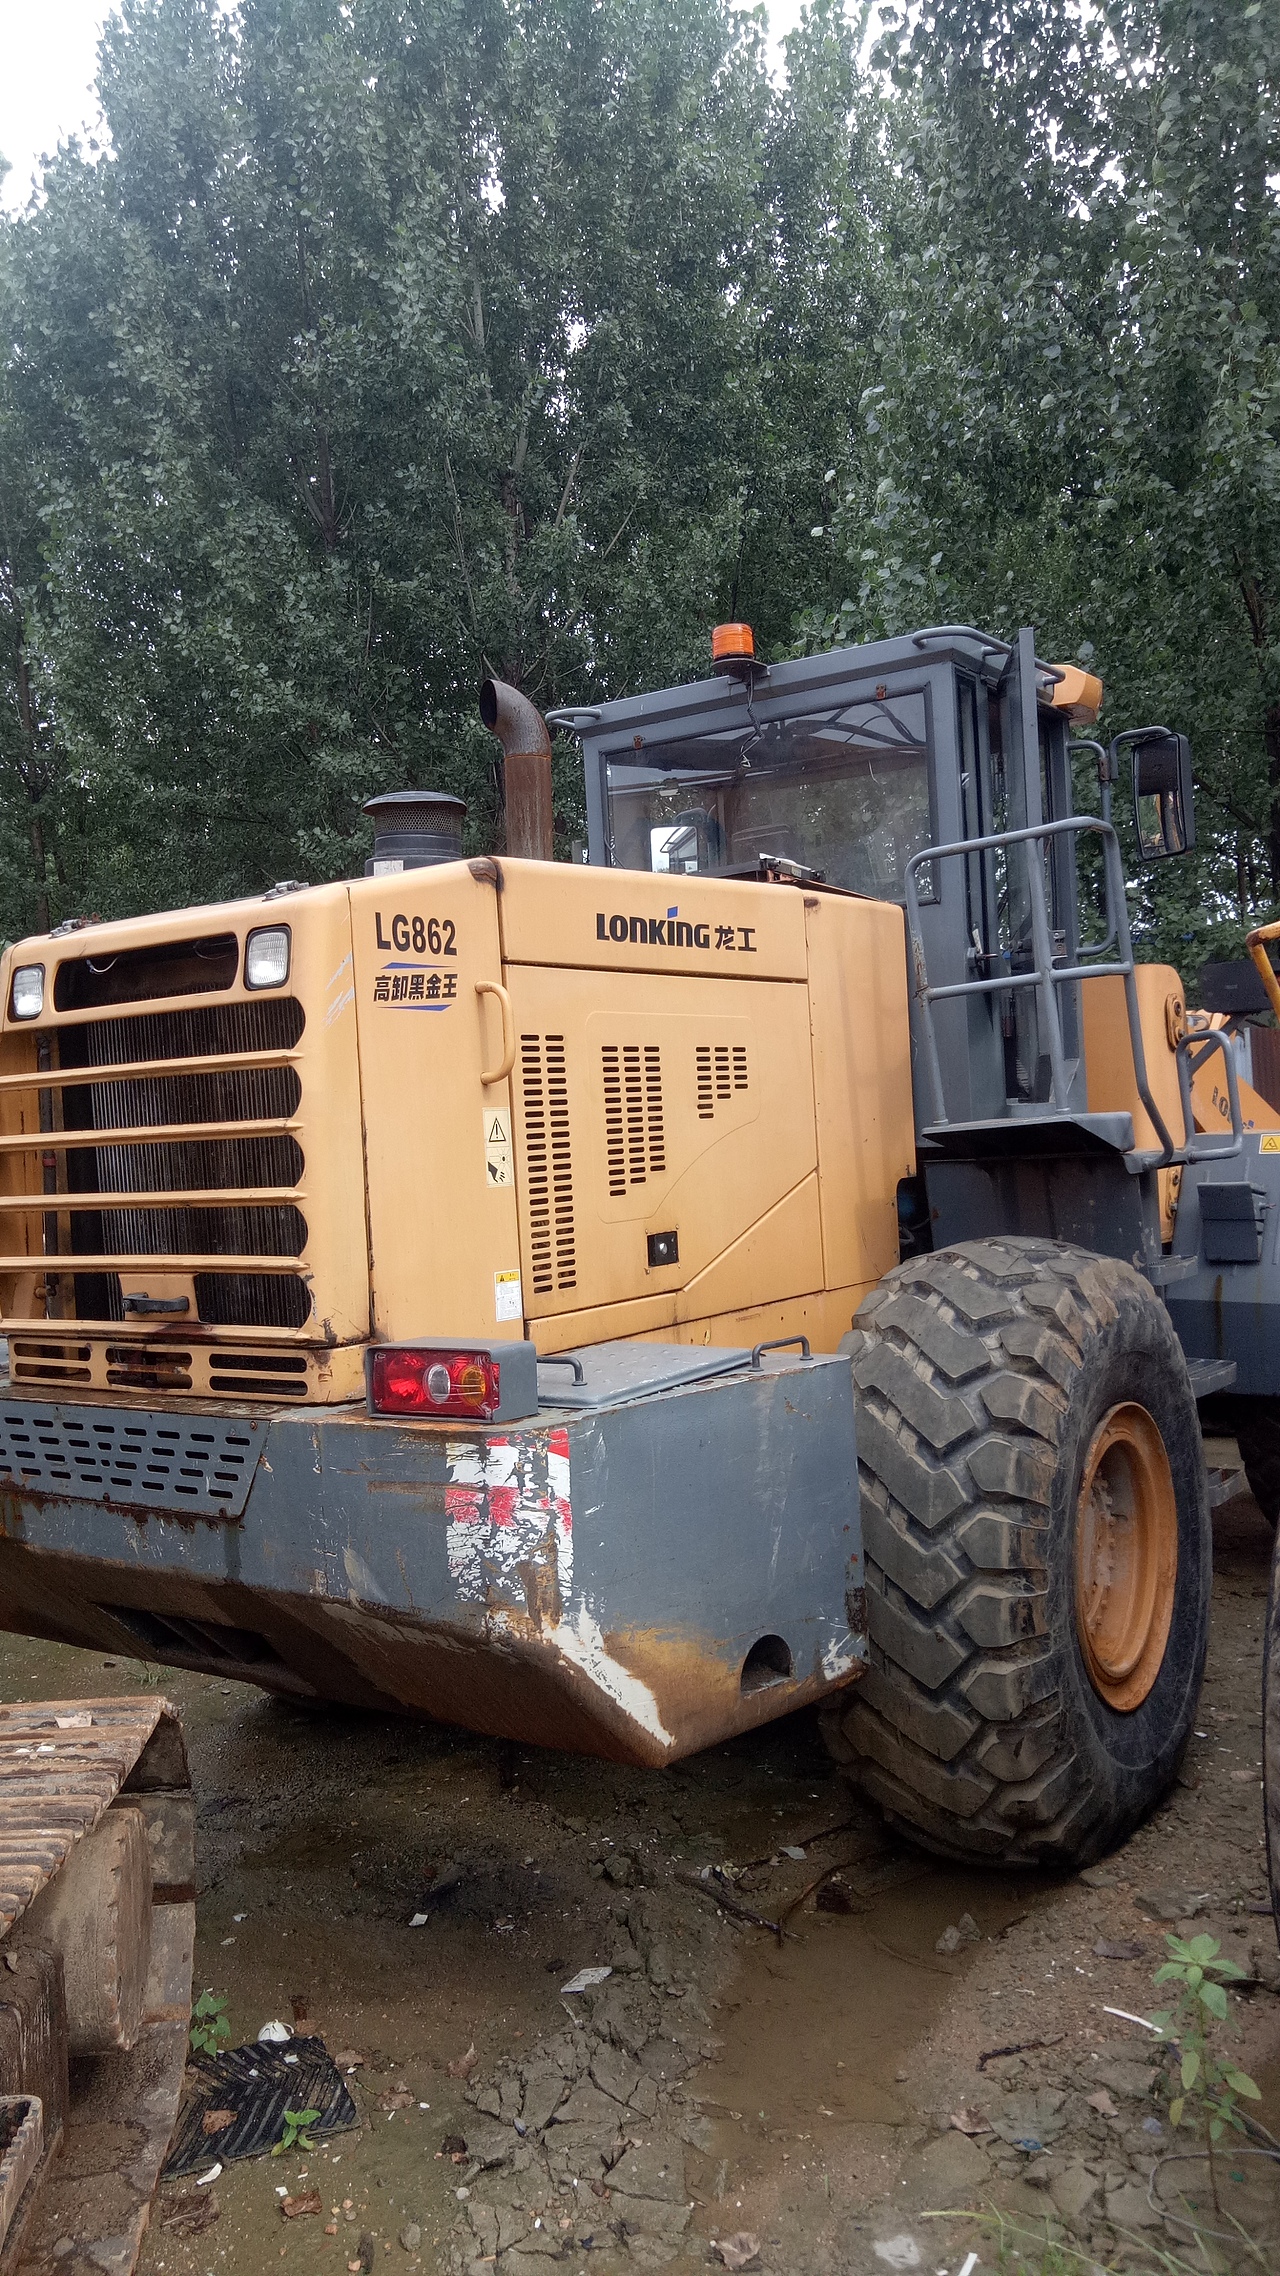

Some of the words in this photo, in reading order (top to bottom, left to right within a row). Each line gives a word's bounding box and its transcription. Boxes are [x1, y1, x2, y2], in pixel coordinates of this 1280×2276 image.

[375, 912, 457, 956] LG862
[714, 925, 757, 952] 龙工
[373, 973, 458, 1002] 高卸黑金王
